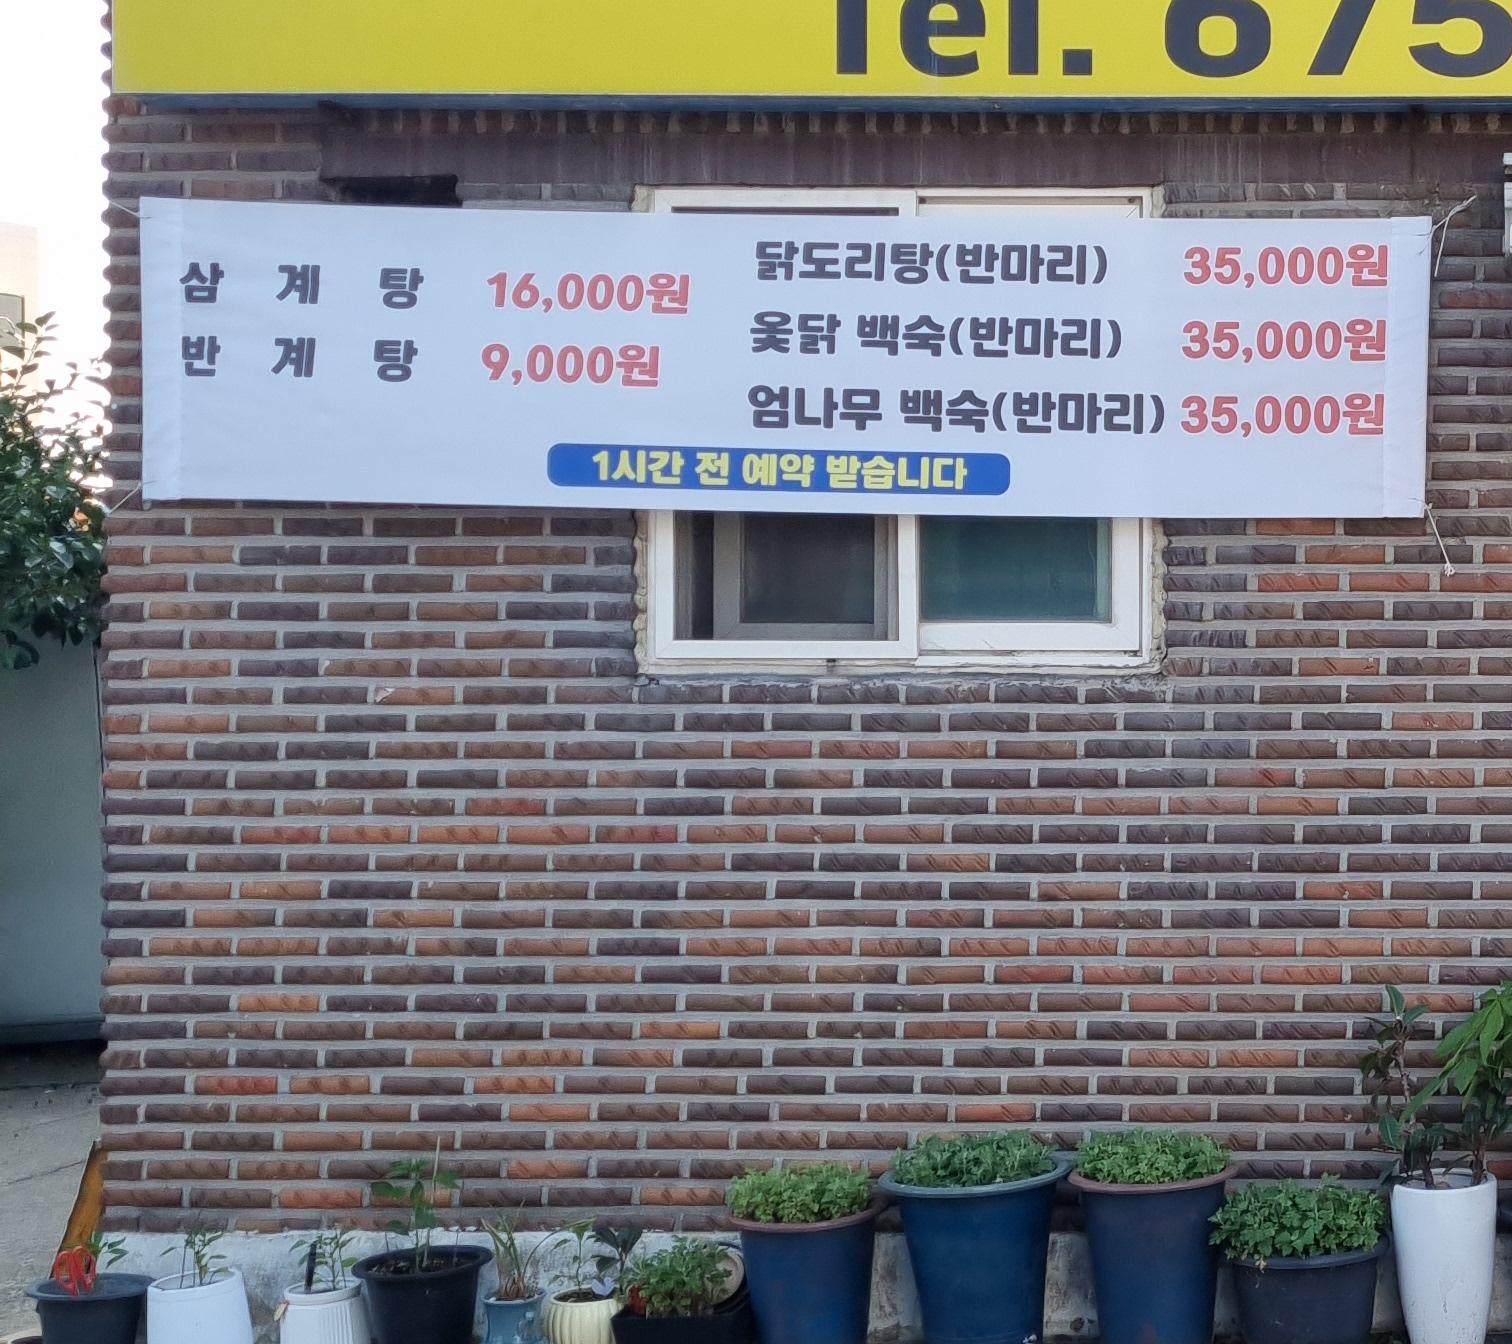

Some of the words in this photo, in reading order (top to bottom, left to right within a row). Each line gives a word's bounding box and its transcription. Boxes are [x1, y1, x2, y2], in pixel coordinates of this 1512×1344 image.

[755, 240, 1109, 287] 닭도리탕(반마리)
[1183, 243, 1390, 289] 35,000원
[486, 270, 691, 316] 16,000원
[749, 311, 841, 355] 옻닭
[856, 314, 1123, 361] 백숙(반마리)
[1181, 318, 1388, 364] 35,000원
[480, 342, 661, 388] 9,000원
[747, 384, 884, 430] 엄나무
[899, 387, 1166, 435] 백숙(반마리)
[1180, 393, 1387, 437] 35,000원
[592, 450, 686, 485] 1시간
[694, 452, 730, 487] 전
[741, 452, 816, 488] 예약
[825, 454, 969, 491] 받습니다
